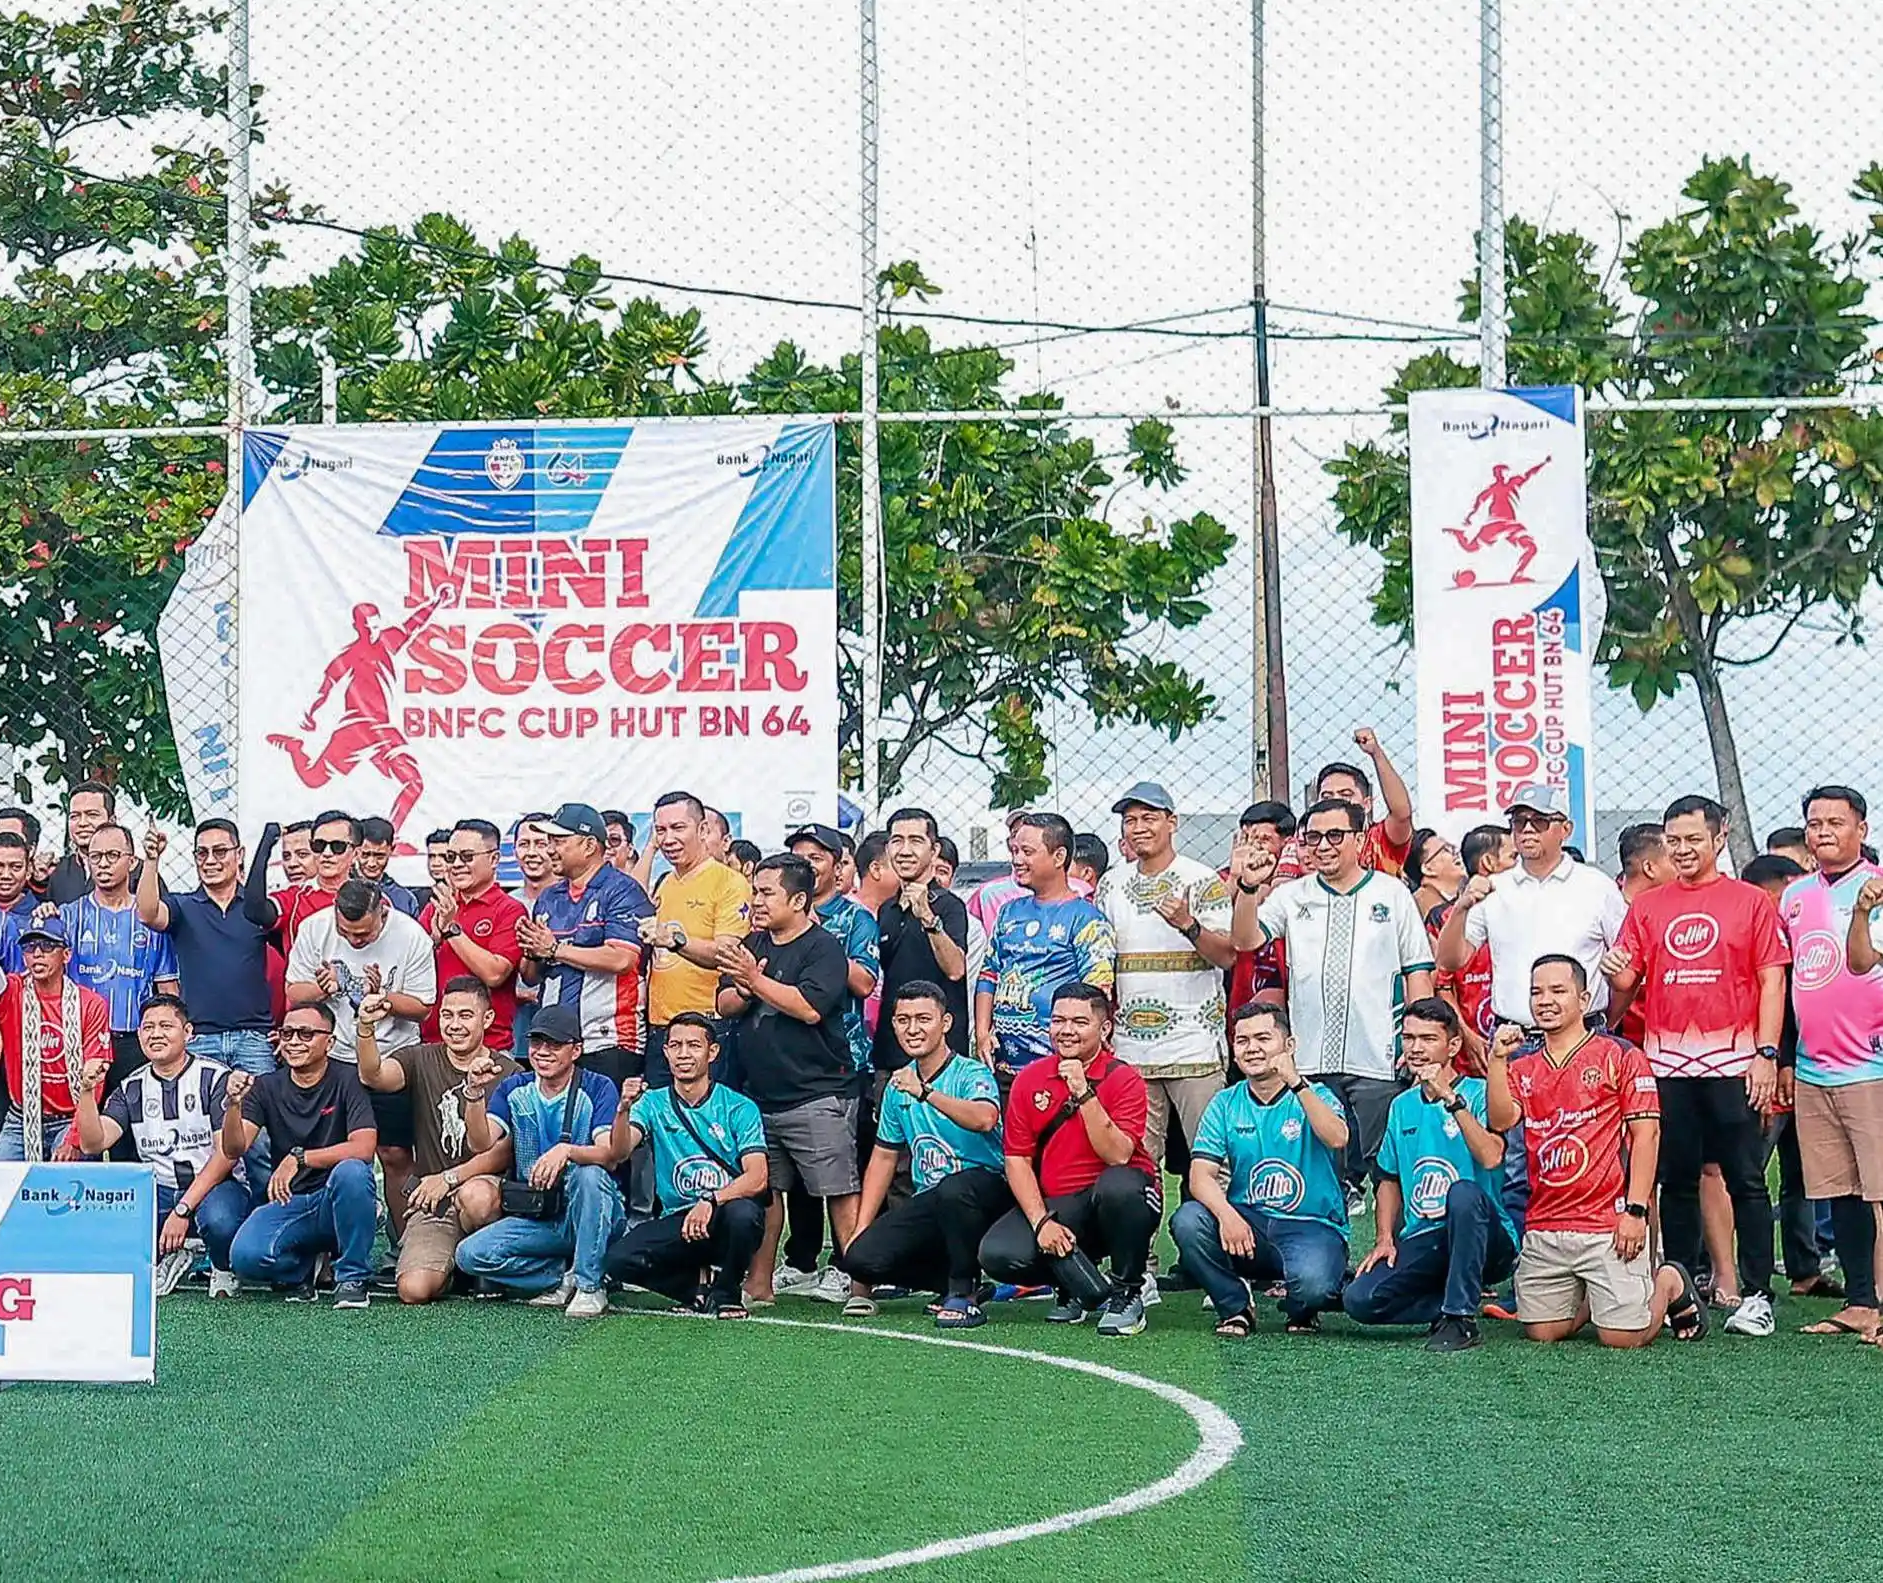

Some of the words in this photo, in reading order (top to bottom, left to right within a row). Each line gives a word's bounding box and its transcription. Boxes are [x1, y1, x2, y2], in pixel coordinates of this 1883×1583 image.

[716, 452, 749, 465] Bank
[403, 538, 650, 609] MINI
[1542, 612, 1562, 635] 64
[403, 620, 808, 696] SOCCER
[1542, 642, 1562, 667] BN
[1544, 672, 1564, 710] HUT
[403, 708, 506, 738] BNFC
[518, 708, 599, 738] CUP
[610, 707, 687, 738] HUT
[699, 705, 749, 737] BN
[761, 704, 811, 736] 64
[1492, 612, 1539, 809] SOCCER
[1545, 715, 1565, 757] CUP
[1442, 691, 1488, 812] MINI
[1673, 923, 1710, 947] ollin
[78, 963, 103, 976] Bank
[1796, 944, 1833, 972] ollin
[1465, 972, 1491, 984] Bank
[1524, 1115, 1552, 1130] Bank
[140, 1137, 166, 1149] Bank
[918, 1147, 948, 1172] ollin
[681, 1167, 718, 1191] ollin
[1254, 1171, 1294, 1201] ollin
[1412, 1171, 1451, 1202] ollin
[21, 1188, 60, 1201] Bank
[85, 1188, 135, 1204] Nagari
